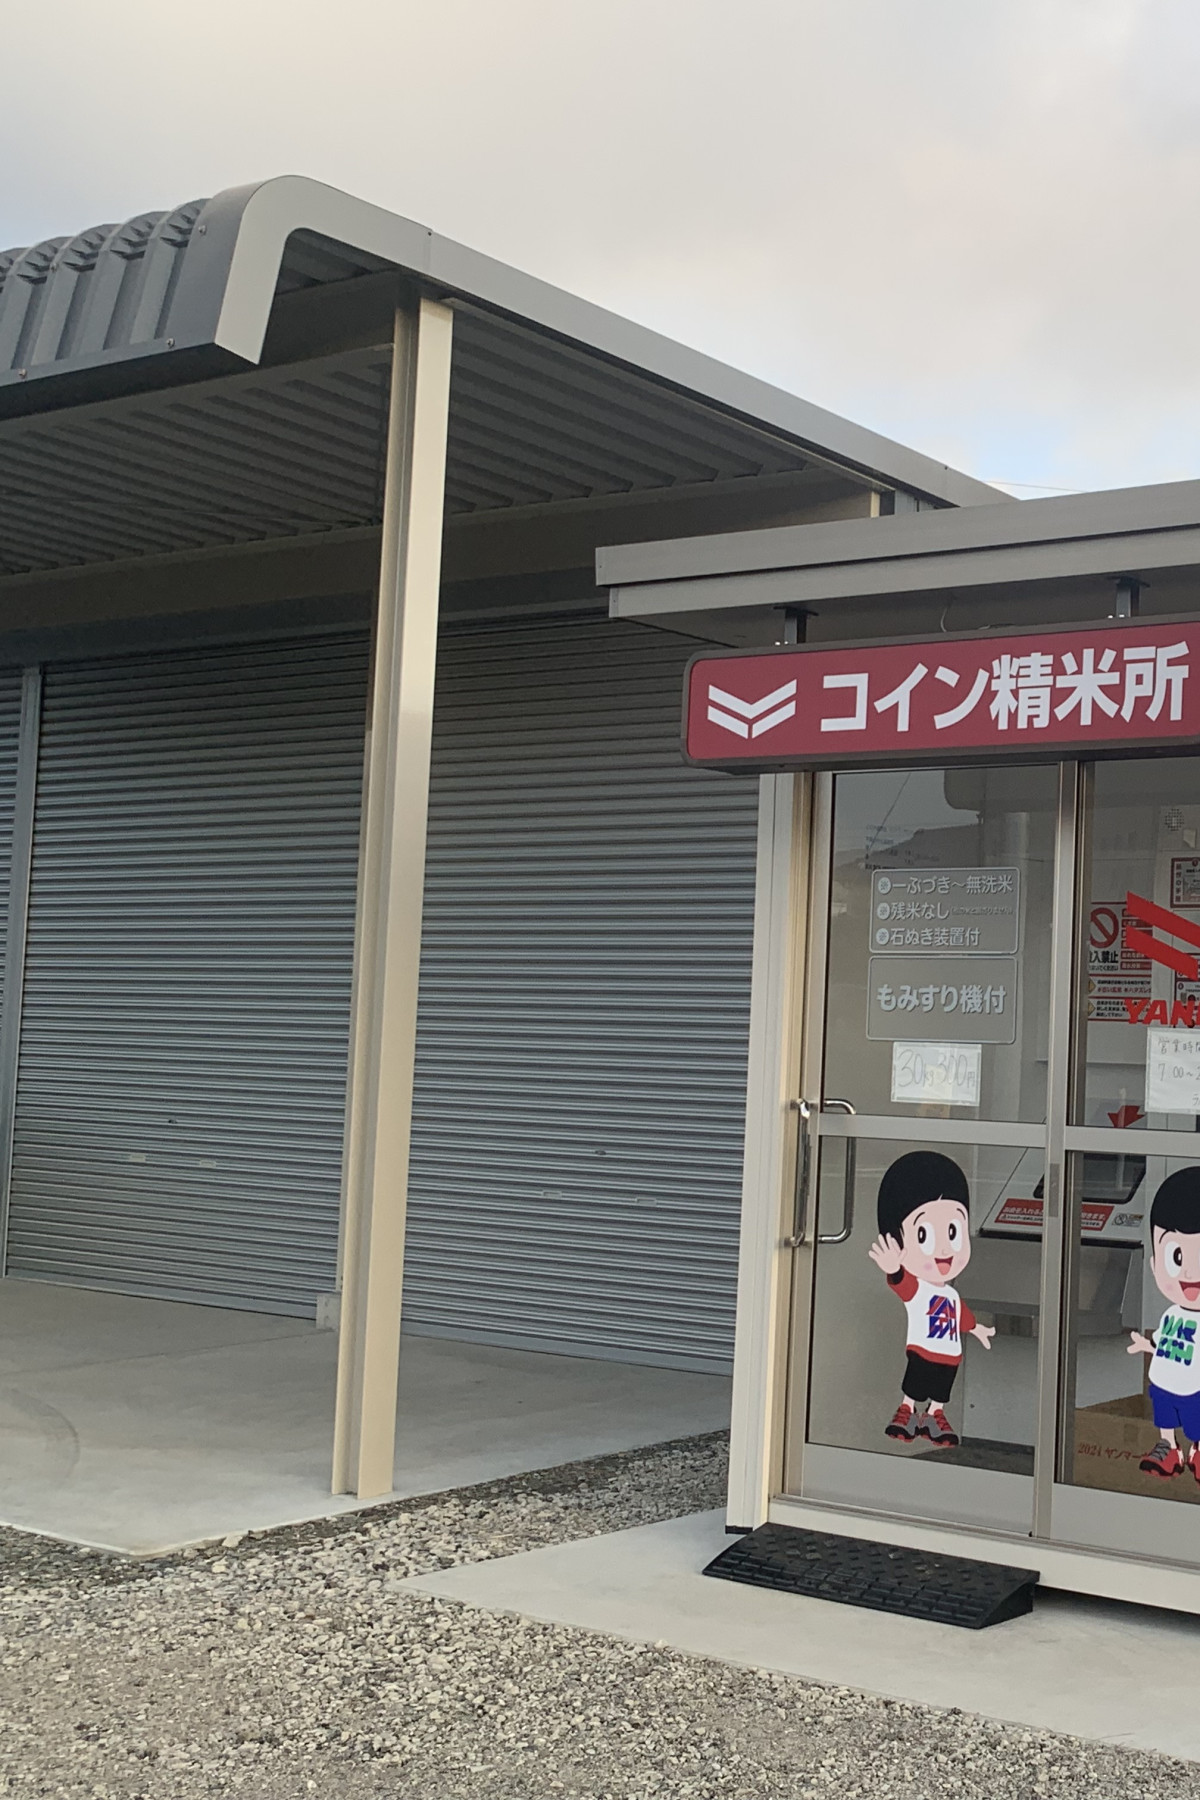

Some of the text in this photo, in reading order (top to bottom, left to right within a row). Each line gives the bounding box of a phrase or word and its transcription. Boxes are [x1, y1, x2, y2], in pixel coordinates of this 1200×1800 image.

[820, 641, 1190, 732] コイン精米所
[890, 902, 950, 921] 残米なし
[889, 927, 981, 947] 石ぬき装置付
[876, 983, 1007, 1014] もみすり機付
